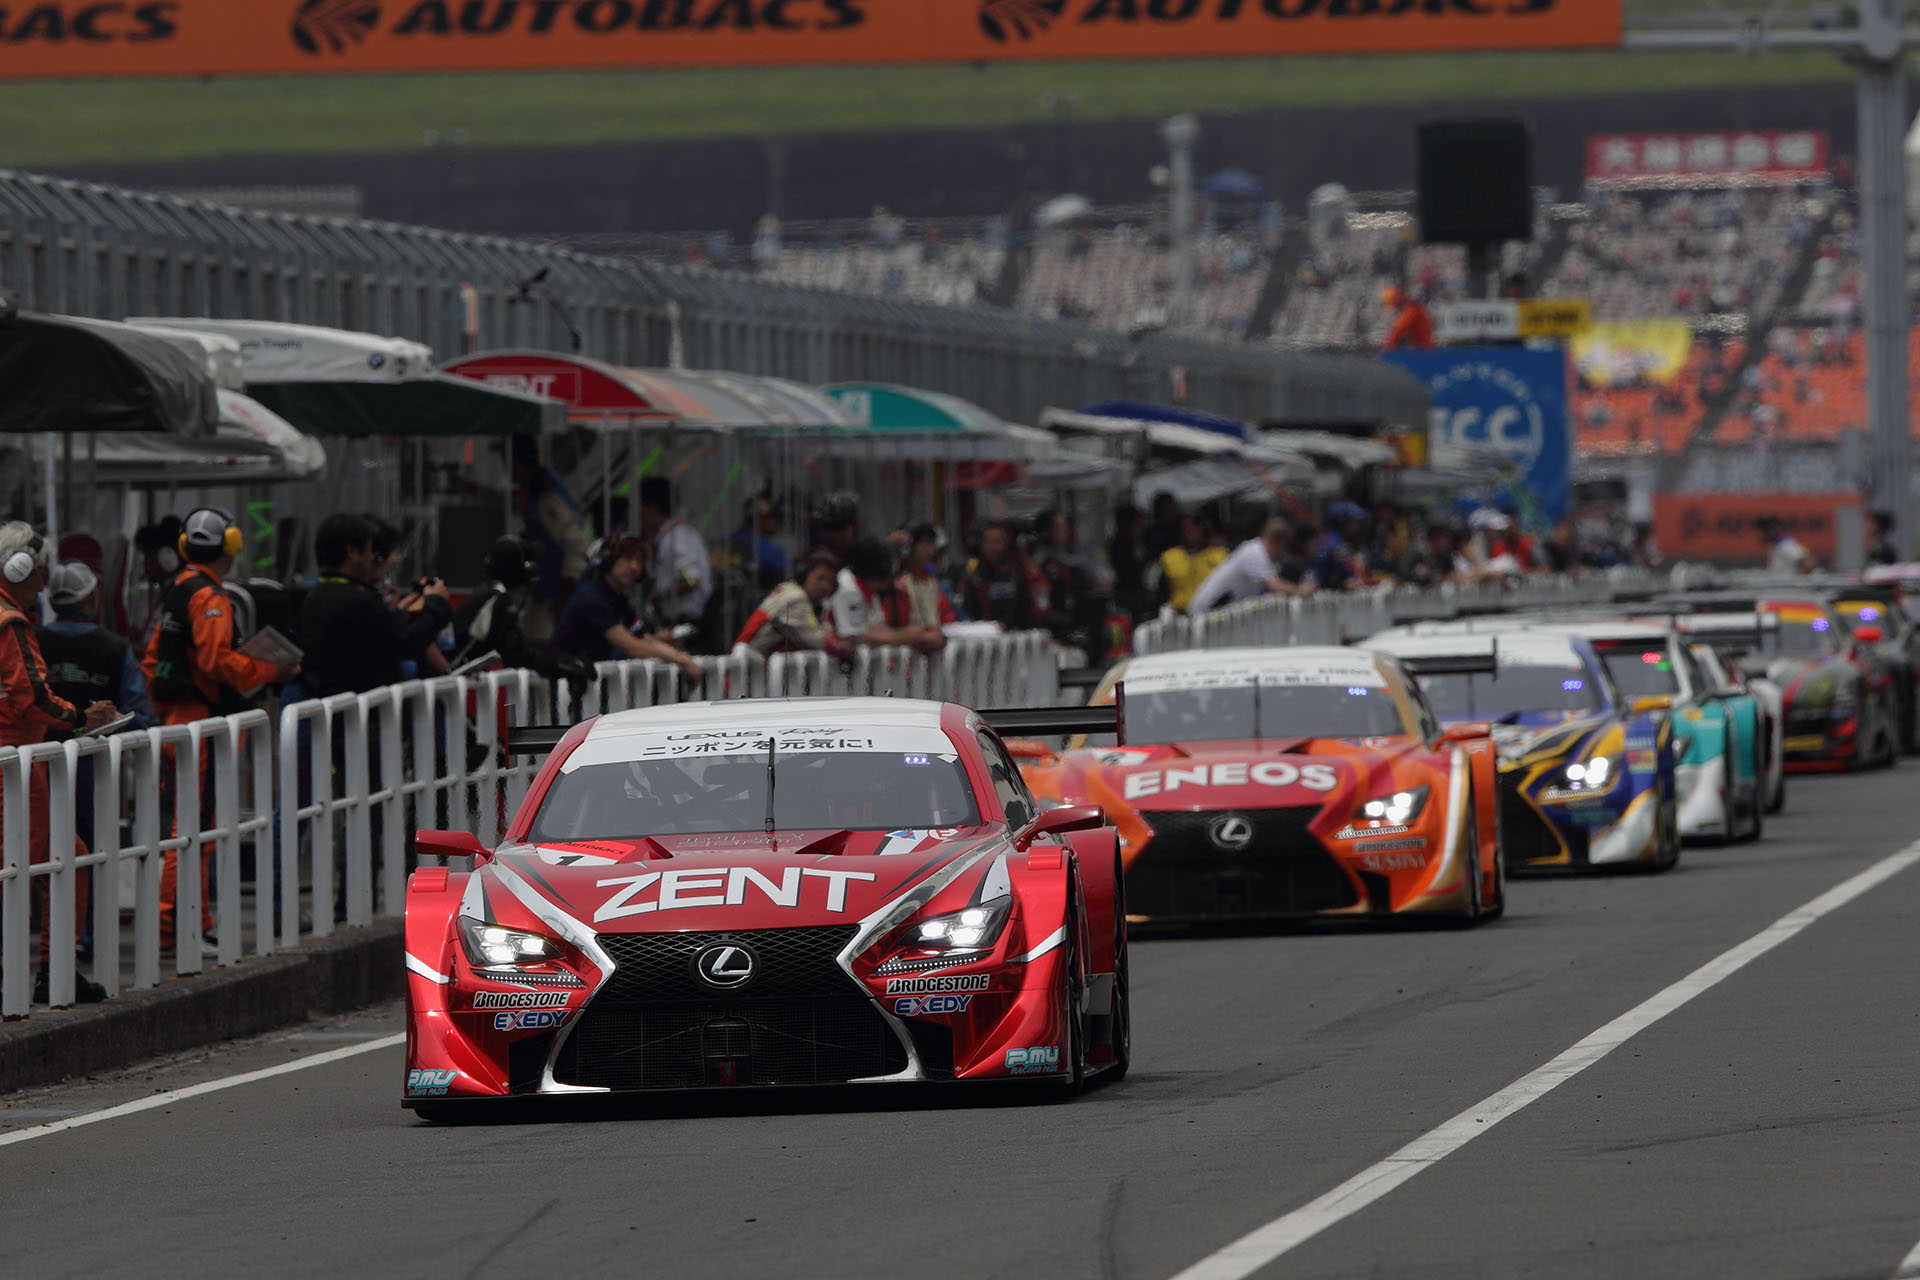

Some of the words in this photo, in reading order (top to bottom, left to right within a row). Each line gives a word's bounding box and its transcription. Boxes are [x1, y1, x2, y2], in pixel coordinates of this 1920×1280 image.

[0, 3, 178, 41] ACS
[390, 0, 868, 35] AUTOBACS
[667, 730, 763, 741] LEXUS
[1124, 762, 1338, 799] ENEOS
[553, 855, 585, 866] 1
[593, 867, 876, 923] ZENT
[886, 975, 990, 994] BRIDGESTONE
[474, 991, 570, 1008] BRIDGESTONE
[895, 995, 972, 1016] EXEDY
[494, 1010, 570, 1031] EXEDY
